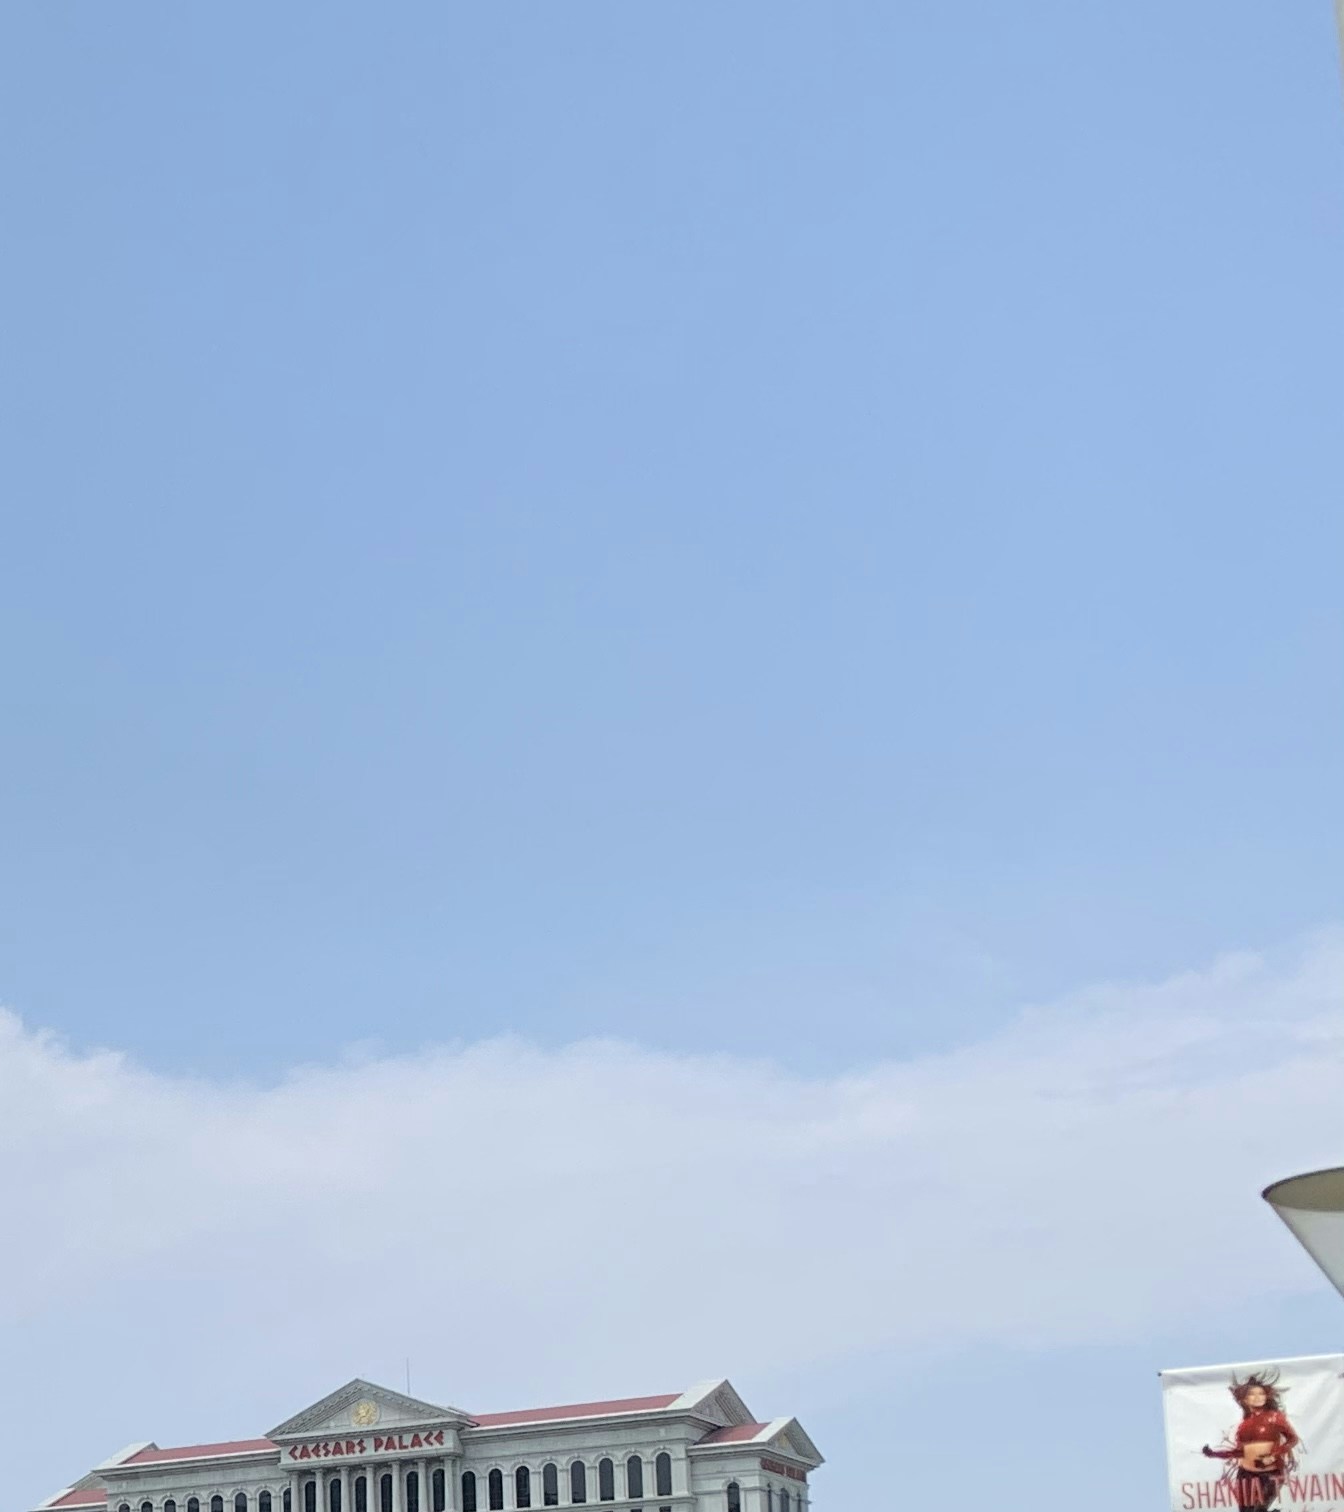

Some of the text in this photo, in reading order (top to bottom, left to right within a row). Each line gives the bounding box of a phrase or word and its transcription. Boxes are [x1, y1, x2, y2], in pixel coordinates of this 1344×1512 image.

[288, 1429, 445, 1461] CAESARS PALACE
[1181, 1472, 1344, 1510] SHANIA TWAIN
